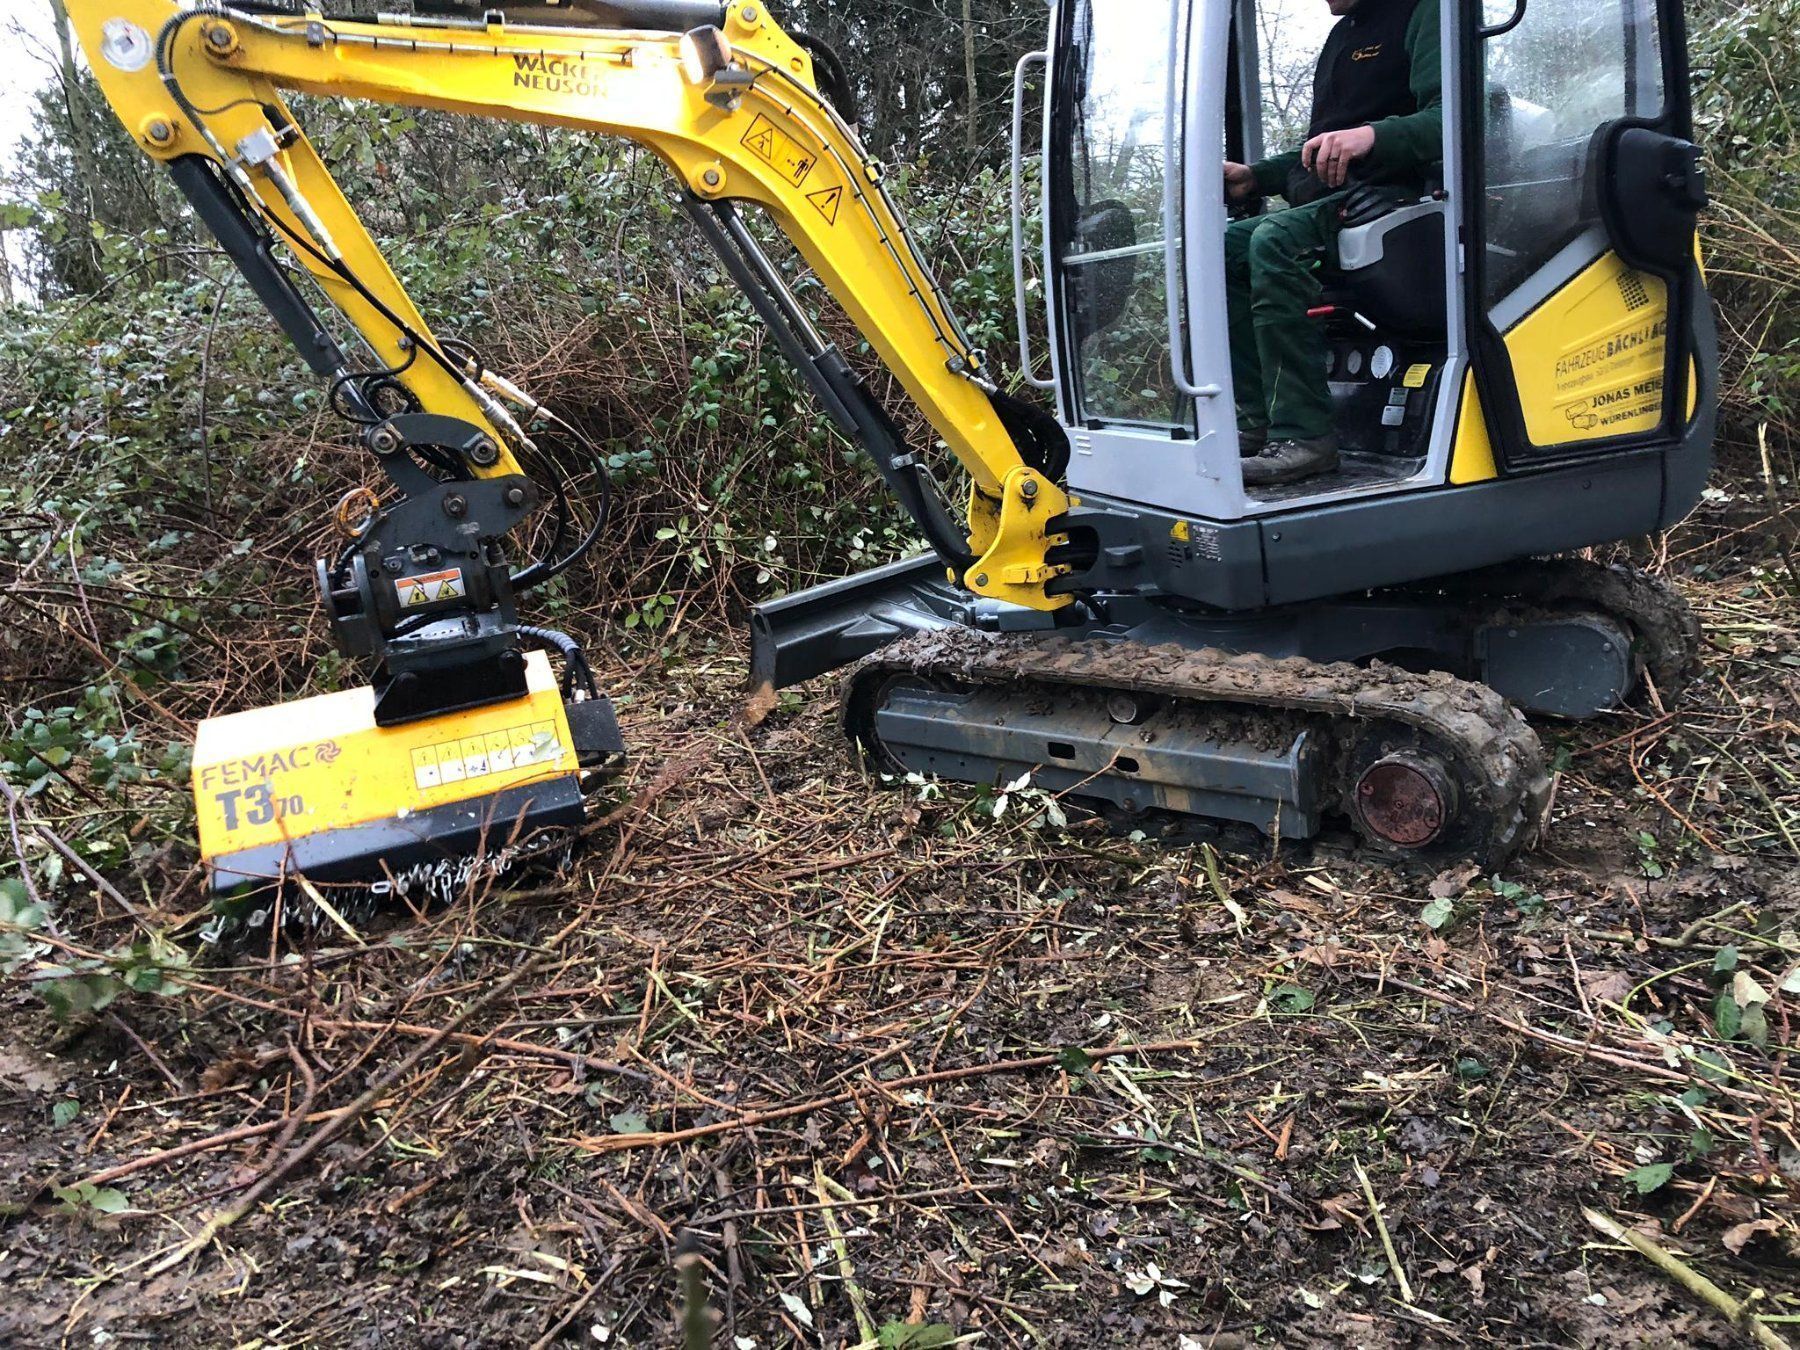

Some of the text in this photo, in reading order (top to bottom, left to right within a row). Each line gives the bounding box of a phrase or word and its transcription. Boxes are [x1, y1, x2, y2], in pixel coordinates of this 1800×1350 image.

[1555, 344, 1605, 378] FAHRZEUG
[1592, 388, 1631, 408] JONAS
[201, 747, 310, 790] FEMAC
